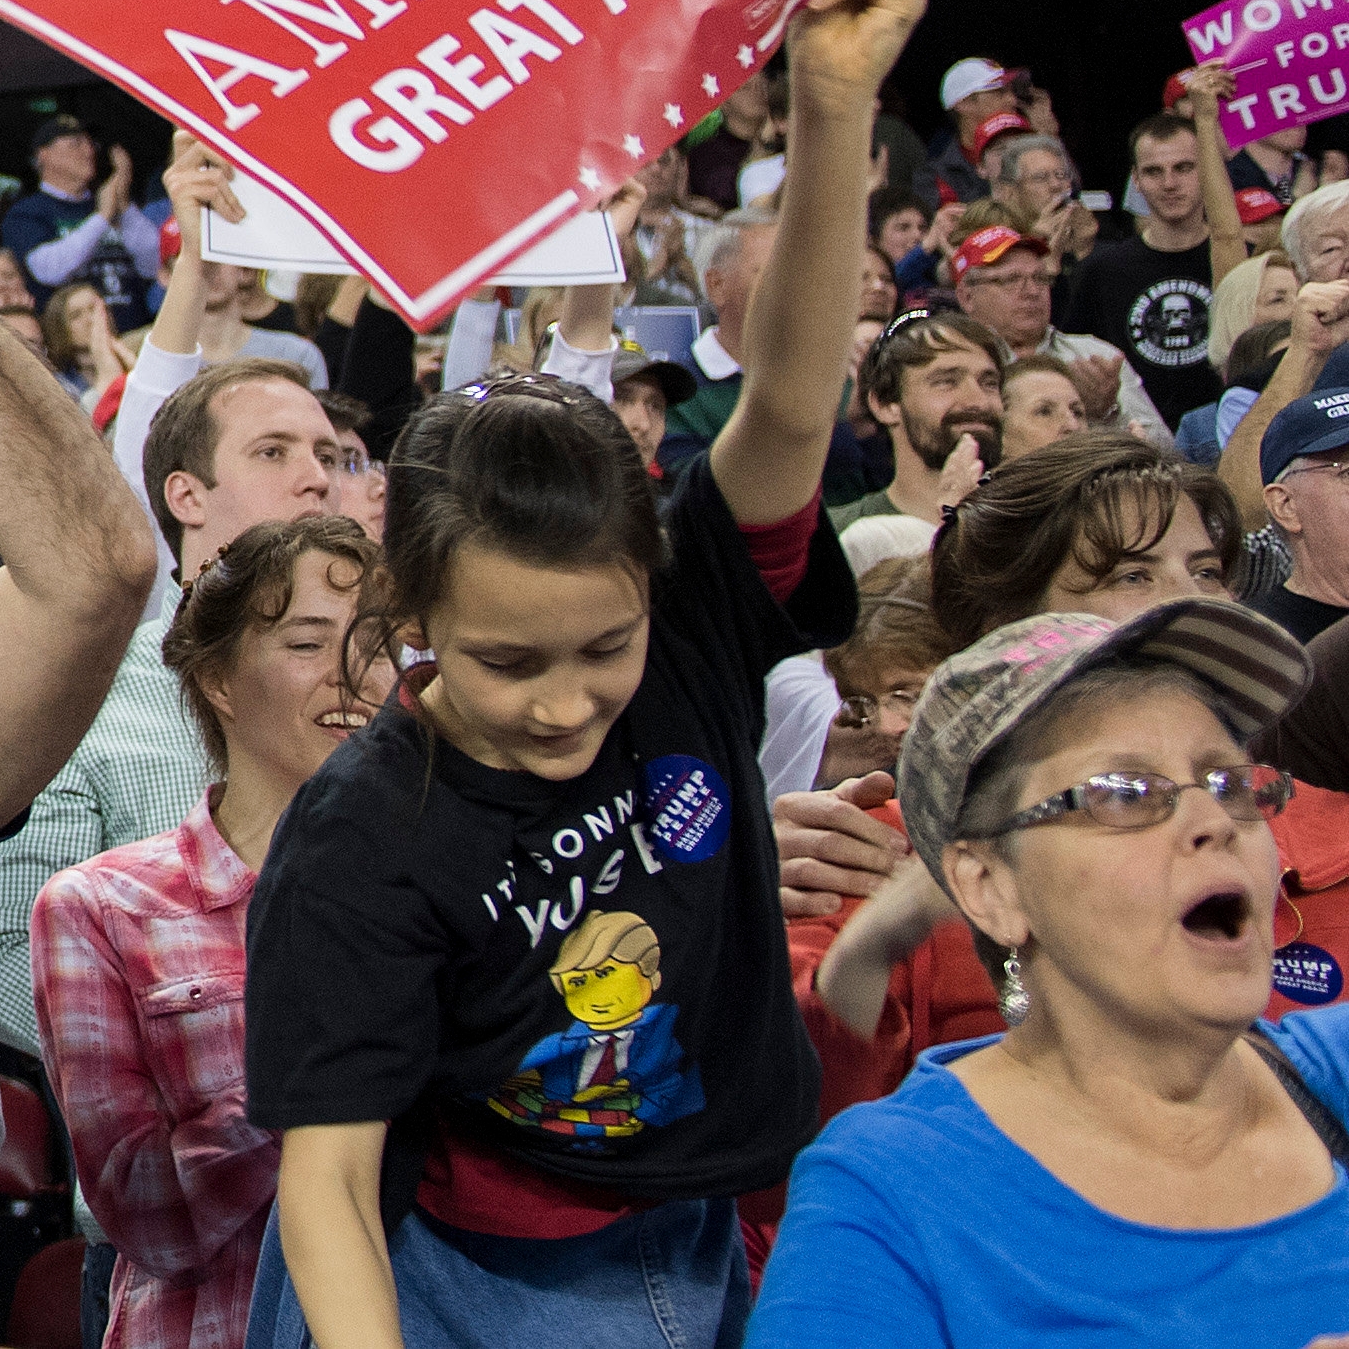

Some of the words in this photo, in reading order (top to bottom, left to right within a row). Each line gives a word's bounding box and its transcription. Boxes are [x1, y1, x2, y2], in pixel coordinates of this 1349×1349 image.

[1274, 23, 1349, 69] FOR
[1226, 67, 1348, 131] TRU
[651, 770, 704, 838] TRUMP
[663, 786, 710, 842] PENCE
[675, 828, 696, 849] MAKE
[683, 828, 705, 851] GREAT
[1272, 959, 1333, 972] RUMP
[1280, 966, 1328, 980] ENCE
